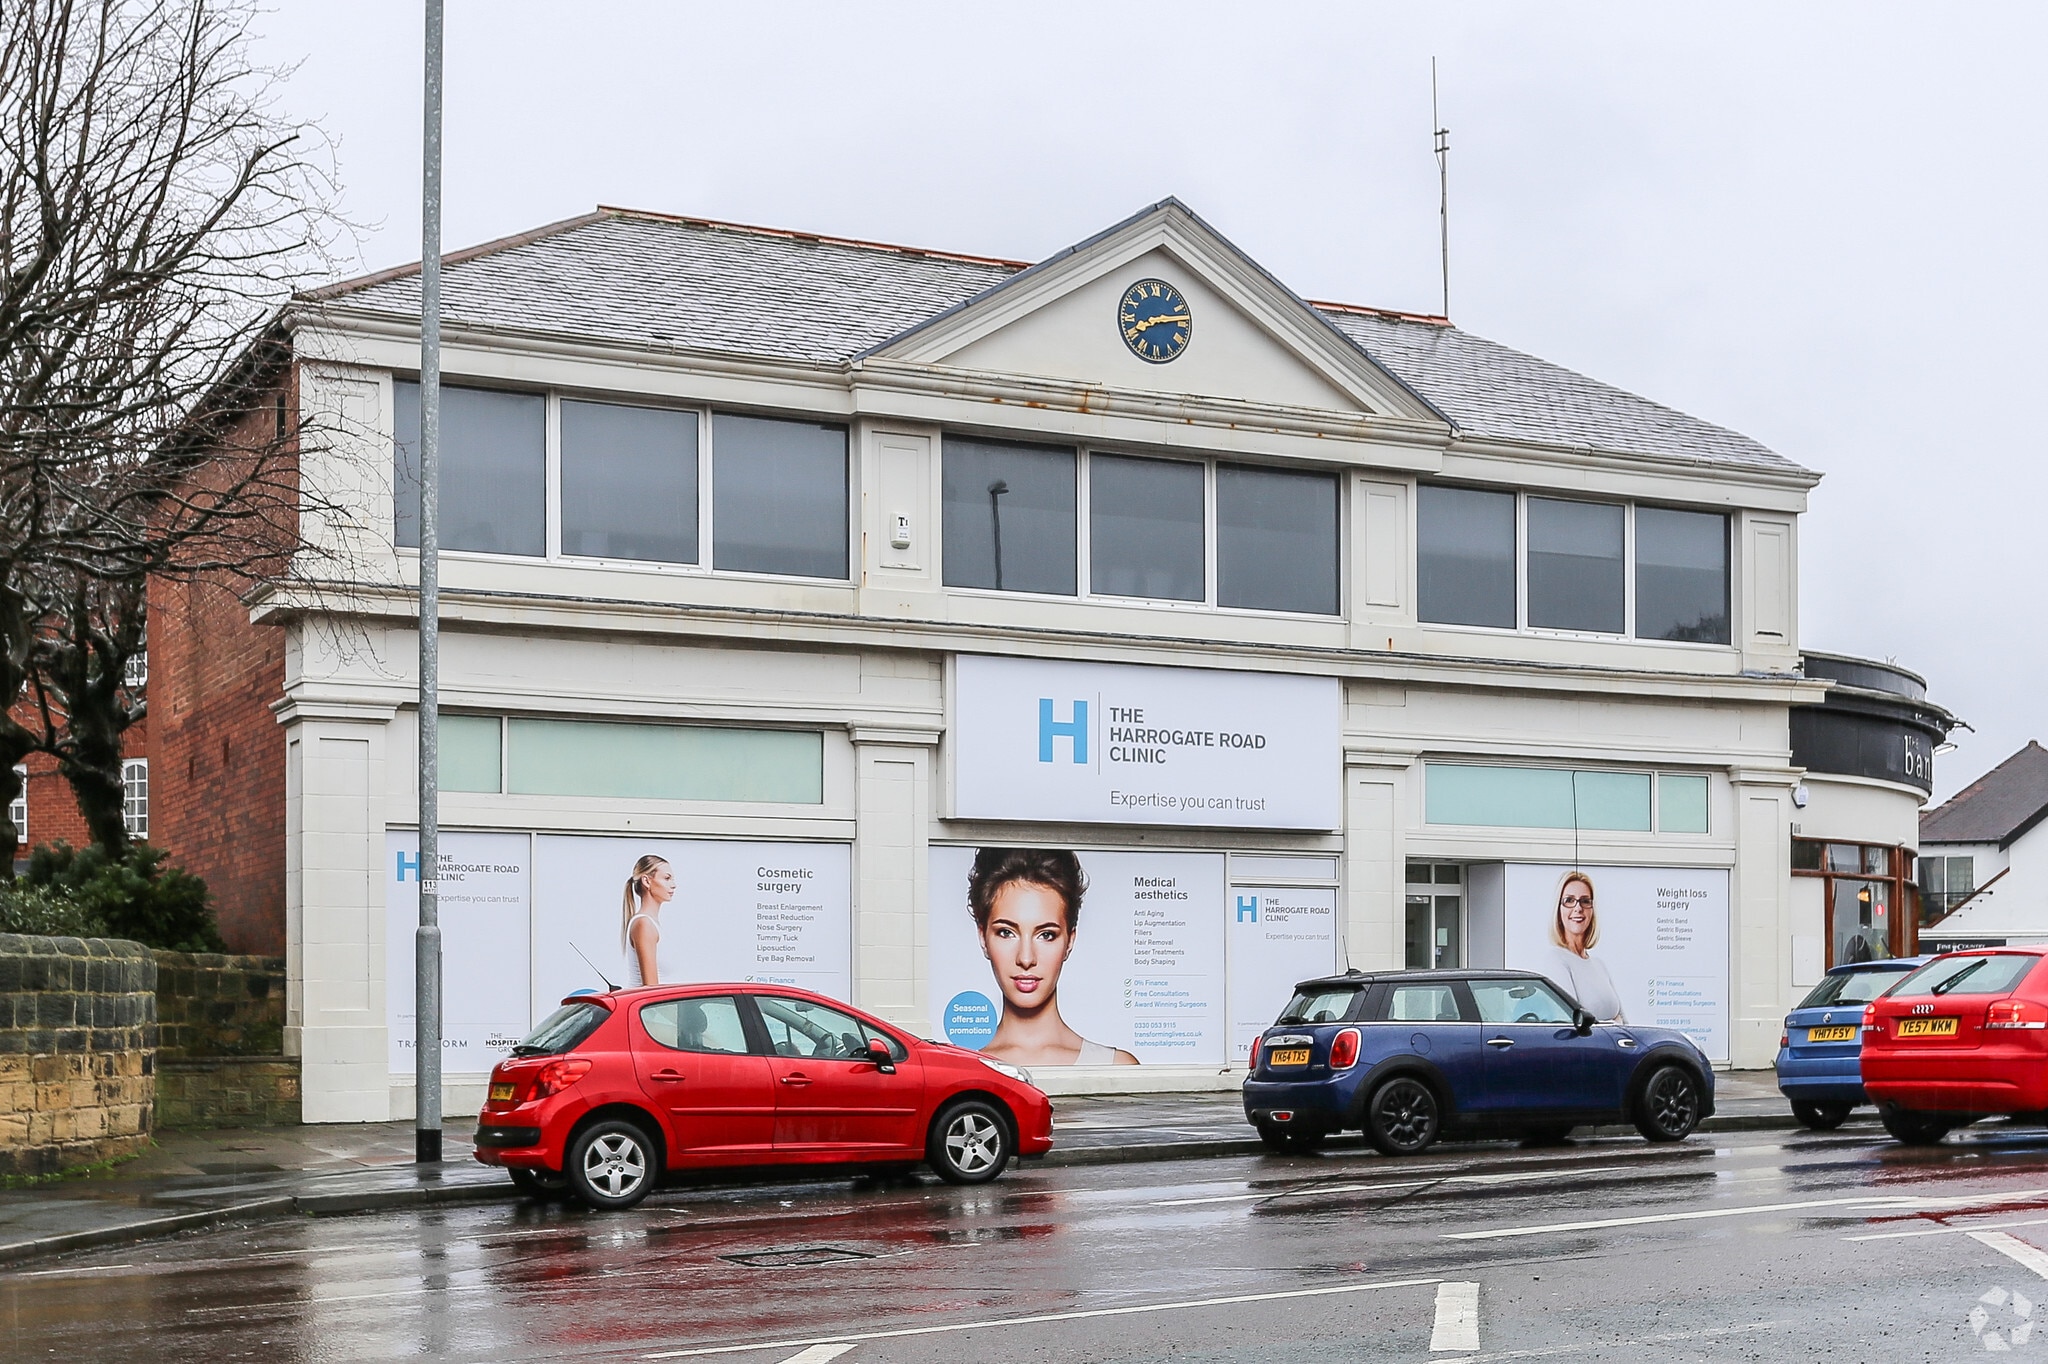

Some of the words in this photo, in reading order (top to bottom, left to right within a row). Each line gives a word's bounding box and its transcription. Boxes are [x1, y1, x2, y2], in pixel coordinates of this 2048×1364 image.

[1110, 707, 1144, 724] THE
[1038, 698, 1088, 764] H
[1110, 727, 1214, 746] HARROGATE
[1220, 733, 1266, 749] ROAD
[1110, 746, 1166, 764] CLINIC
[1904, 735, 1932, 784] ban
[1110, 790, 1176, 808] Expertise
[1180, 797, 1204, 811] you
[1208, 798, 1232, 809] can
[1236, 796, 1266, 810] trust
[397, 852, 420, 882] H
[436, 864, 492, 872] HARROGATE
[494, 865, 520, 873] ROAD
[757, 866, 814, 879] Cosmetic
[757, 882, 802, 894] surgery
[1134, 877, 1176, 887] Medical
[436, 894, 471, 904] Expertise
[472, 896, 486, 904] you
[502, 895, 519, 903] trust
[1134, 890, 1188, 900] aesthetics
[1657, 888, 1688, 899] Weight
[1690, 889, 1708, 898] loss
[780, 904, 824, 912] Enlargement
[1237, 896, 1257, 922] H
[1657, 901, 1690, 910] surgery
[776, 924, 802, 932] Surgery
[757, 934, 781, 942] Tummy
[757, 944, 796, 952] Liposuction
[1903, 1021, 1929, 1033] YE57
[1930, 1020, 1952, 1032] WKM
[1814, 1029, 1832, 1039] YH17
[1832, 1028, 1850, 1038] FSY
[1274, 1050, 1291, 1062] YK64
[1293, 1050, 1307, 1062] TXS
